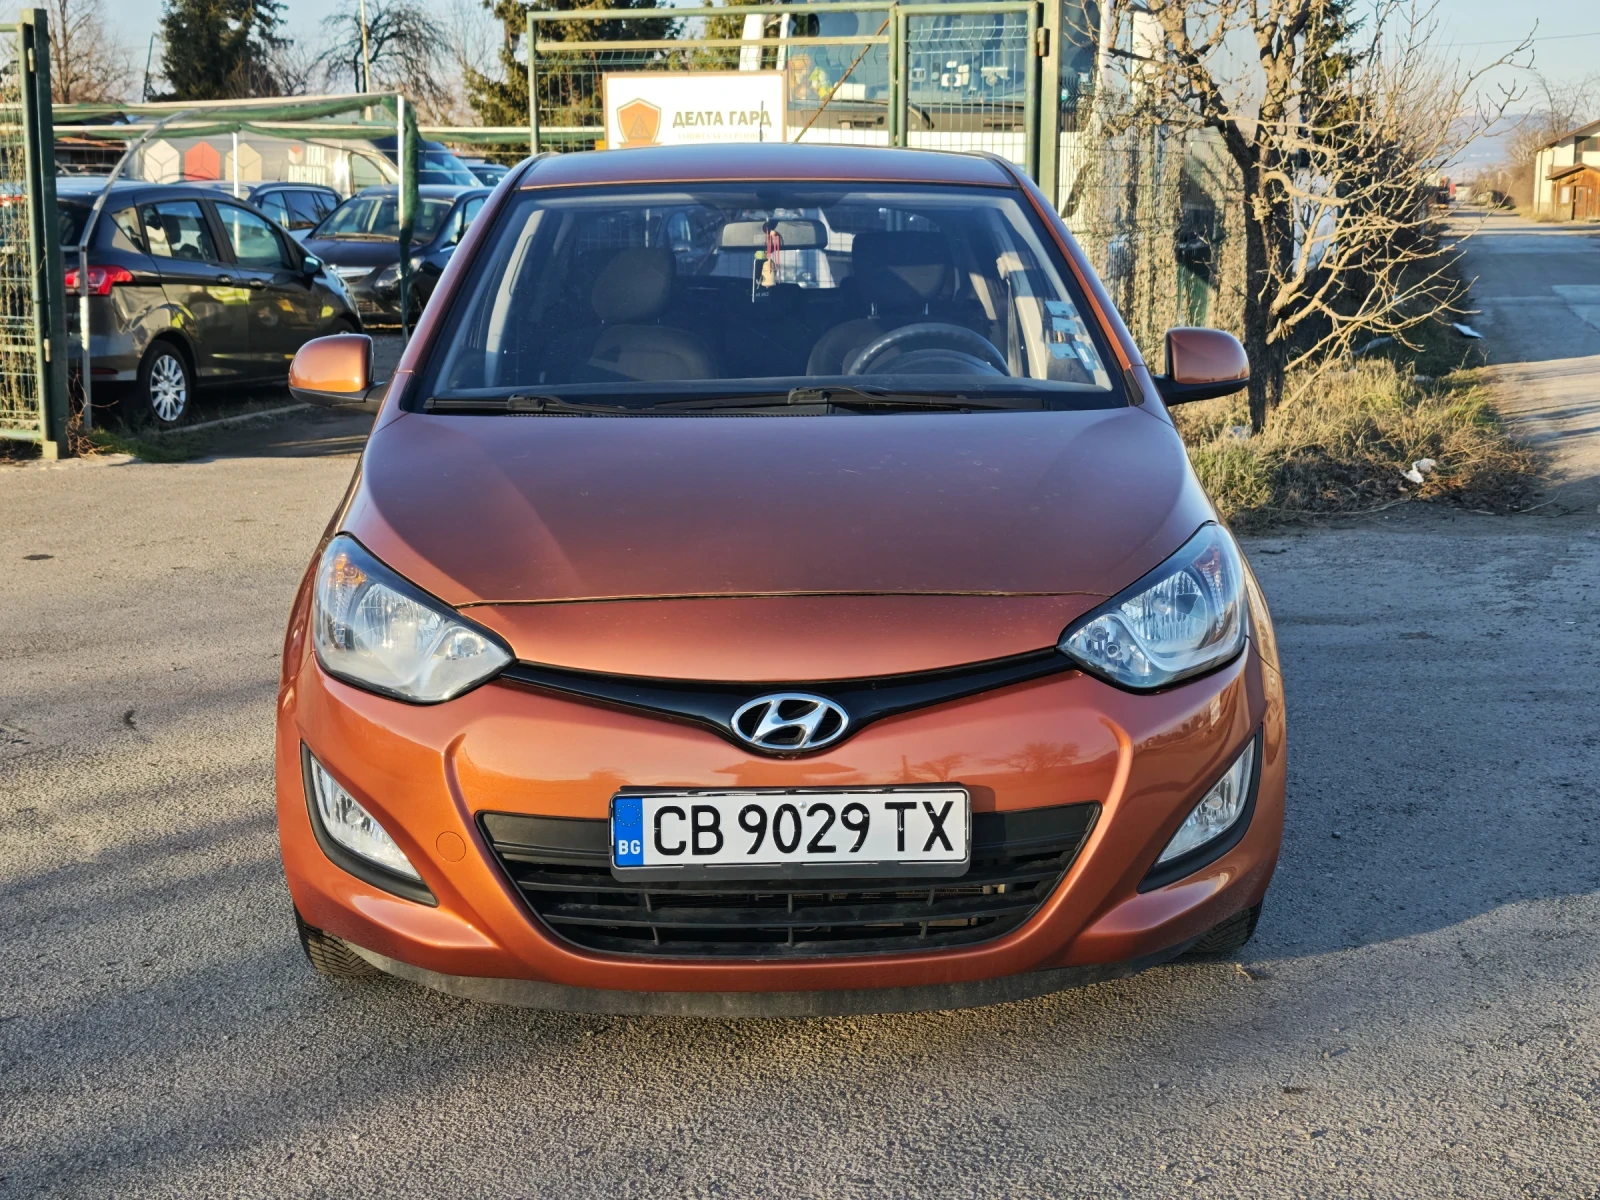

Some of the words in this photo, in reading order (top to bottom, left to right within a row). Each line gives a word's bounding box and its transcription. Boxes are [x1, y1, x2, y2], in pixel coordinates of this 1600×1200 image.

[672, 111, 724, 129] ДЕЛТА
[729, 110, 773, 128] ГАРД
[653, 804, 724, 856] CB
[737, 801, 871, 855] 9029
[884, 800, 955, 852] TX
[617, 839, 642, 855] BG
